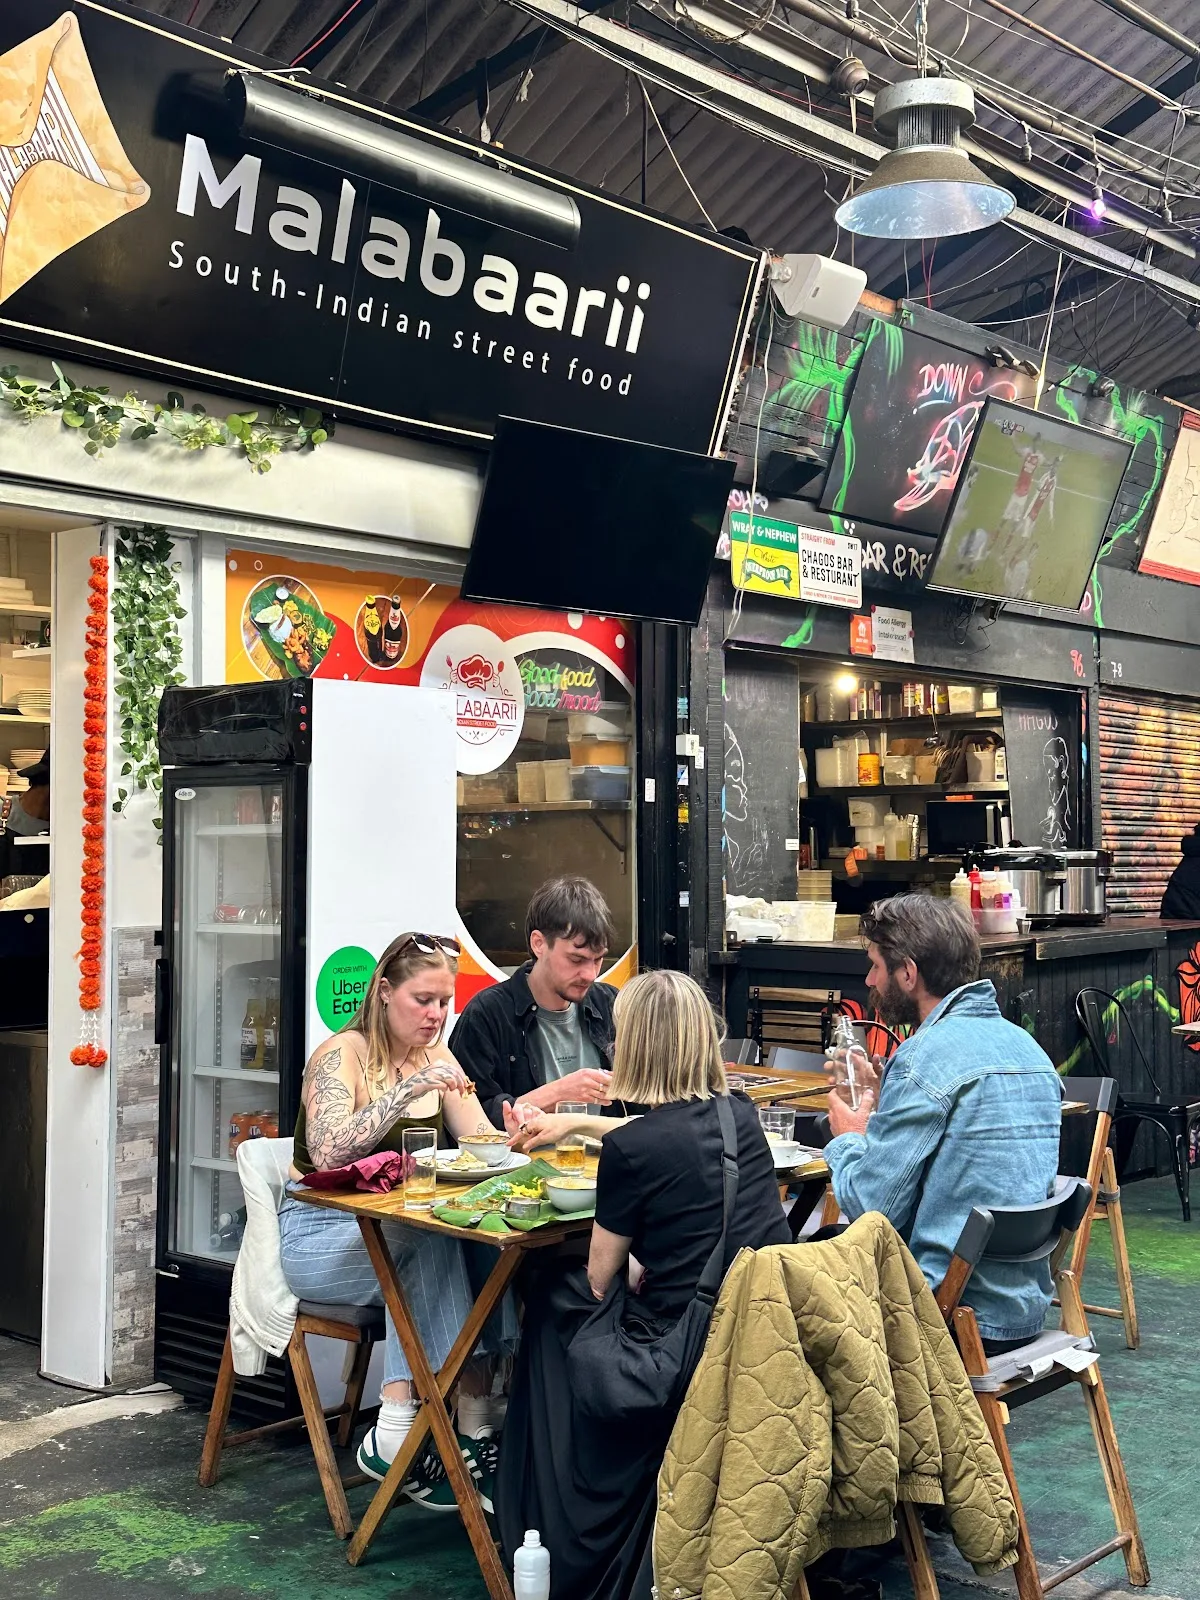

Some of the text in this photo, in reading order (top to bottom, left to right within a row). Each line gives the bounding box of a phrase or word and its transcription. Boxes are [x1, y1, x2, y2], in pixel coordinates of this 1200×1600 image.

[177, 133, 650, 354] Malabaarii
[168, 240, 632, 396] South-Indian street food
[917, 362, 969, 403] DOWN
[757, 525, 765, 537] &
[765, 528, 797, 544] NEPHEW
[801, 549, 853, 572] CHAGOS BAR
[802, 564, 860, 587] & RESTURANT
[520, 659, 597, 690] Good food
[1111, 661, 1123, 679] 78
[457, 698, 517, 720] LABAARII
[558, 690, 601, 711] mood
[332, 979, 367, 996] Uber
